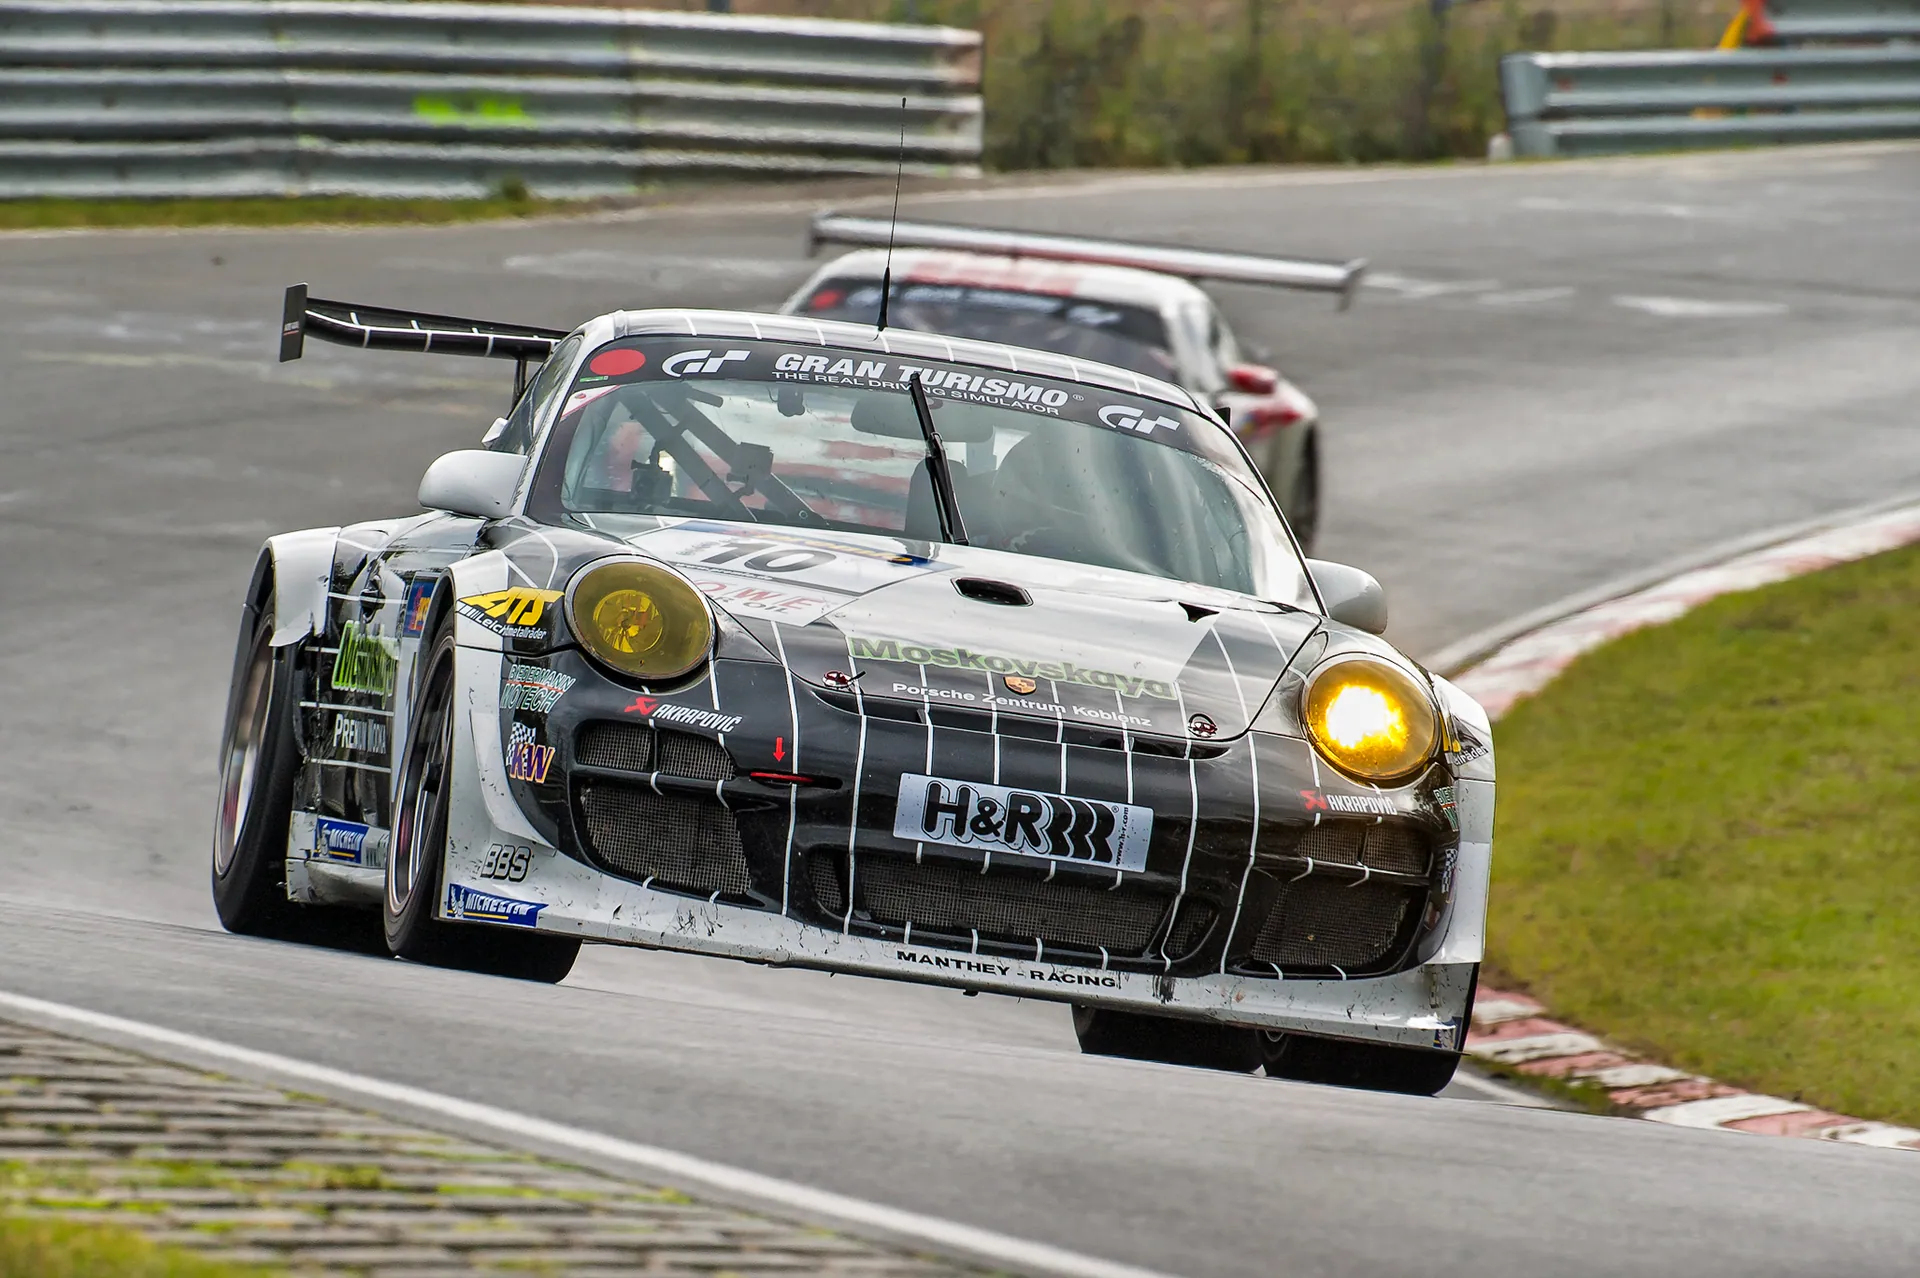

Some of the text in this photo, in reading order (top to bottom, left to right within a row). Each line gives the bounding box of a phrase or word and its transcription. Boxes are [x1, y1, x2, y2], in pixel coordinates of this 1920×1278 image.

[775, 353, 887, 379] GRAN
[772, 371, 811, 382] THE
[815, 374, 864, 386] REAL
[951, 390, 1060, 416] SIMULATOR
[699, 542, 838, 573] 10
[459, 586, 566, 626] ATS
[508, 663, 577, 692] BIEDERMANN
[849, 636, 1179, 700] Moskovskaya
[499, 683, 565, 714] MOTECH
[893, 682, 1152, 727] Porsche Zentrum Koblenz
[510, 742, 556, 784] KW
[1115, 806, 1130, 867] www.h-r.com
[480, 843, 534, 882] BBS
[465, 893, 537, 917] MICHELIN
[896, 950, 1010, 976] MANTHEY
[1029, 969, 1117, 988] RACING
